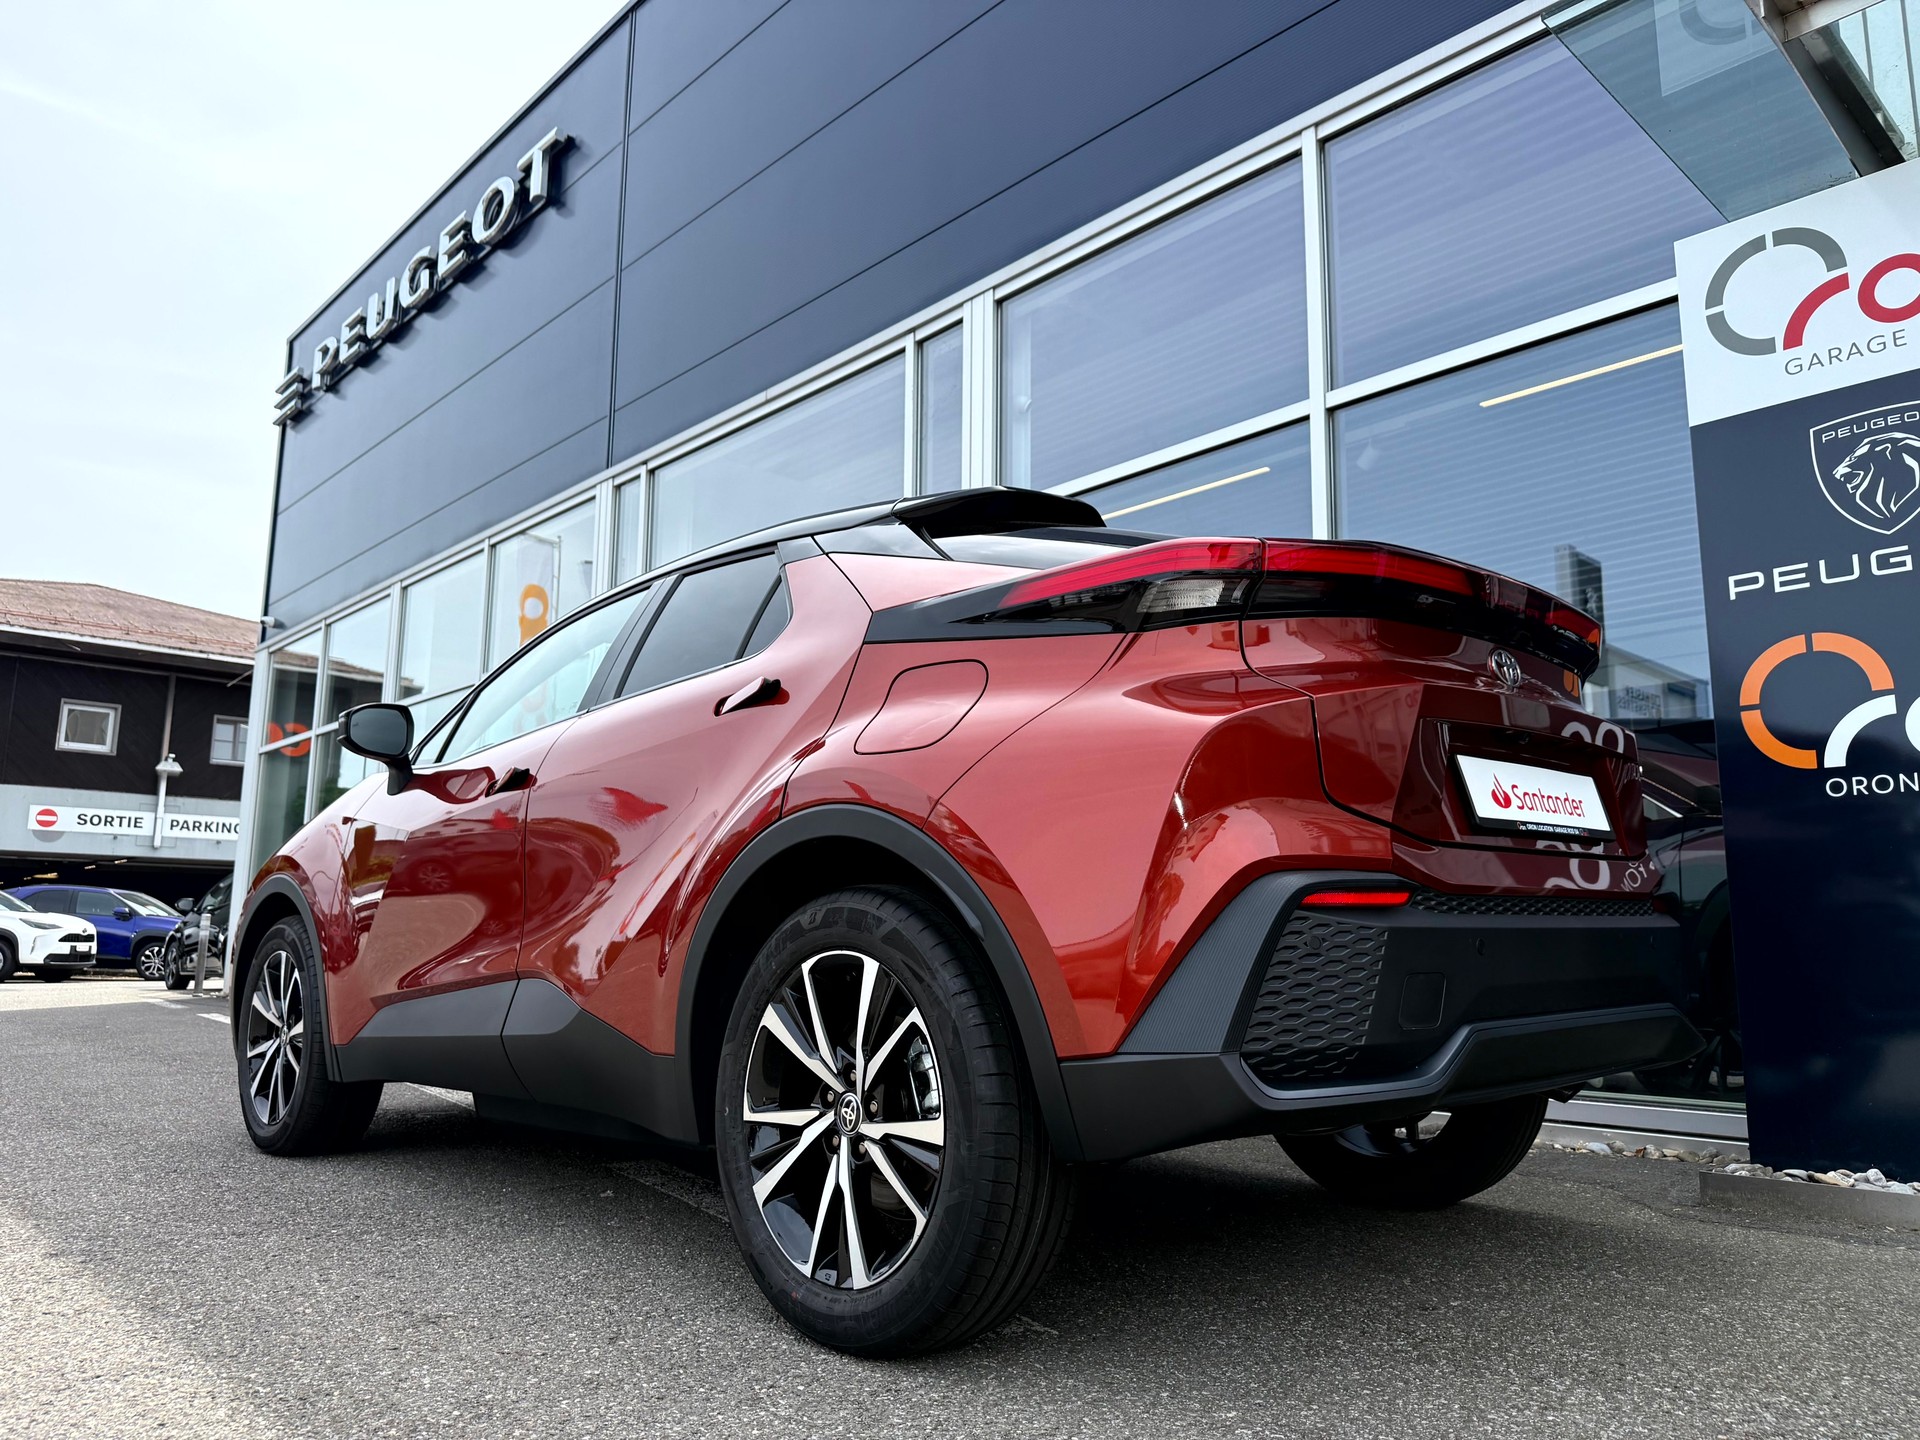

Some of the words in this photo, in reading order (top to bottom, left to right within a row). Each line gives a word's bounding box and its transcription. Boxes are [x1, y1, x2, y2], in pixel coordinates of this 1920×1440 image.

[311, 126, 569, 391] PEUGEOT
[1784, 328, 1908, 376] GARAGE
[1821, 411, 1920, 444] PEUGEO
[1728, 544, 1913, 601] PEUG
[1511, 784, 1585, 818] Santander
[1825, 771, 1920, 797] ORON
[76, 813, 144, 829] SORTIE
